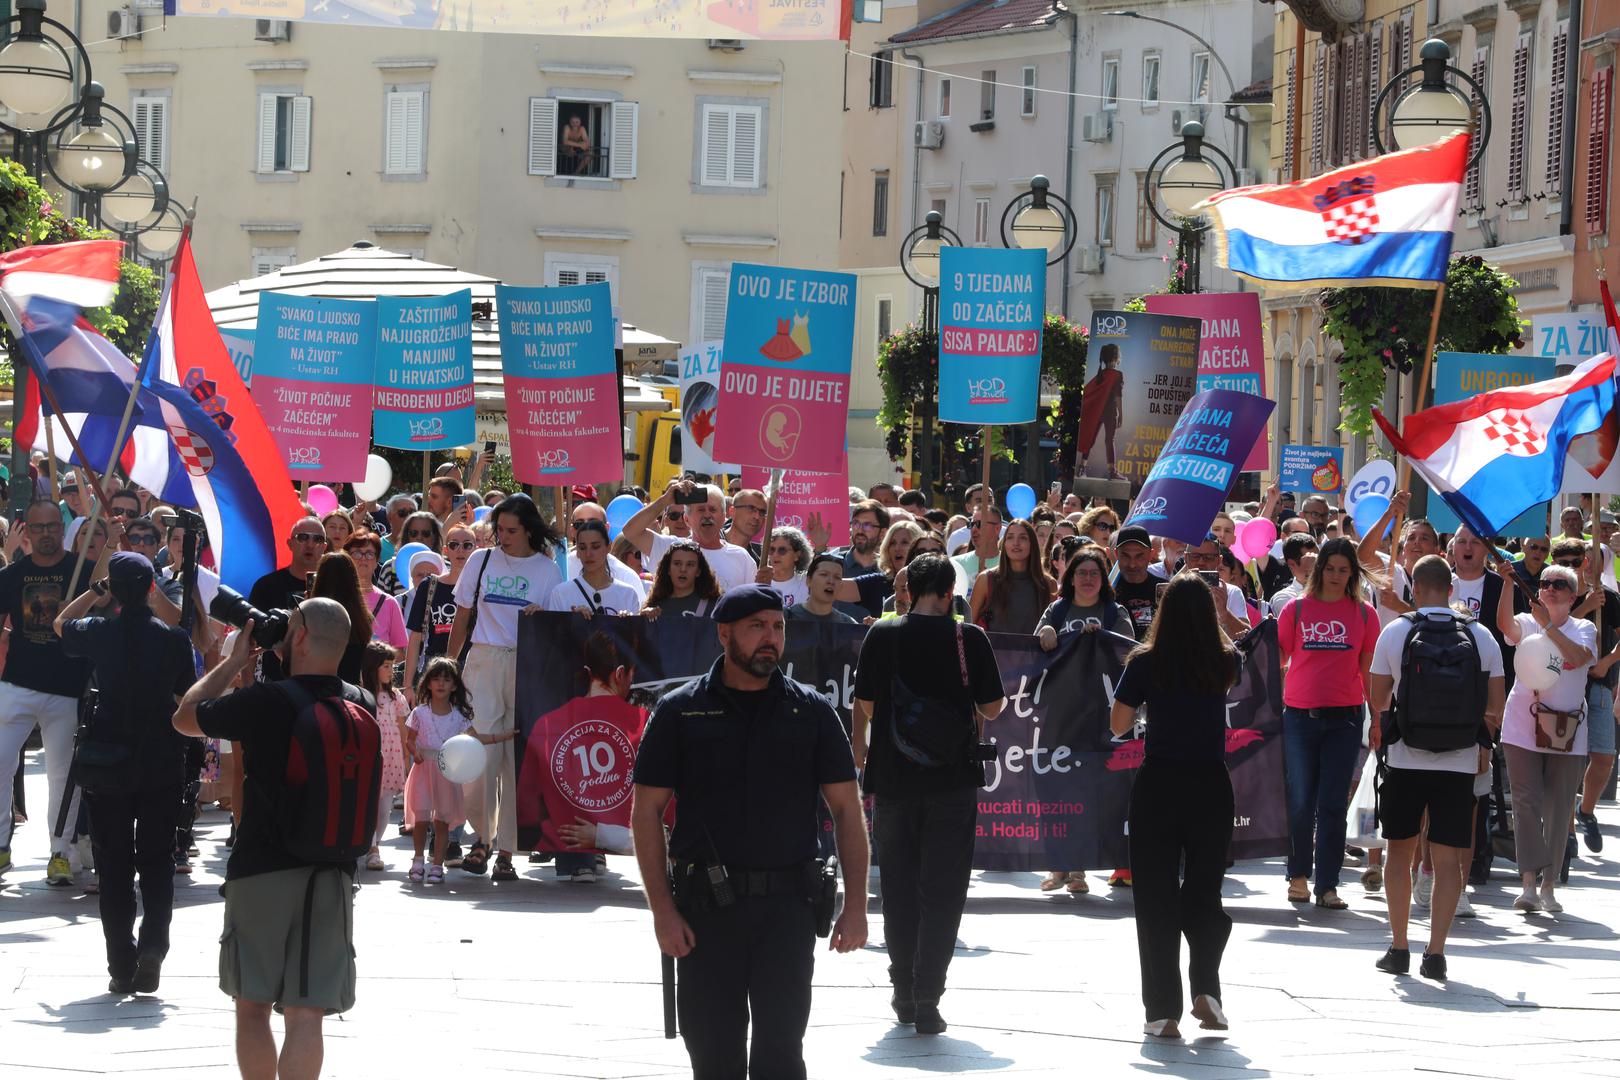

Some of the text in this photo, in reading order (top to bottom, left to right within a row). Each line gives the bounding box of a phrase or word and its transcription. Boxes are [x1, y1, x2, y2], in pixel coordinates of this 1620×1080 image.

[738, 274, 850, 306] OVO JE IZBOR
[954, 272, 1033, 293] 9 TJEDANA
[398, 304, 458, 324] ZAŠTITIMO
[544, 298, 592, 315] LJUDSKO
[952, 300, 1032, 323] OD ZAČEĆA
[317, 310, 361, 326] LJUDSKO
[1096, 316, 1127, 330] HOD
[277, 324, 358, 345] BIĆE IMA PRAVO
[381, 322, 469, 344] NAJUGROŽENIJU
[511, 319, 530, 336] BIĆE
[534, 321, 554, 336] IMA
[557, 319, 593, 336] PRAVO
[1160, 326, 1177, 338] ONA
[944, 330, 973, 352] SISA
[978, 333, 1025, 353] PALAC
[1540, 320, 1608, 356] ZA ŽIV
[290, 347, 304, 360] NA
[402, 346, 456, 365] MANJINU
[524, 343, 538, 357] NA
[1198, 345, 1250, 369] AČEĆA
[298, 364, 320, 374] Ustav
[324, 366, 338, 375] RH
[533, 360, 558, 370] Ustav
[560, 360, 576, 370] RH
[683, 354, 702, 379] ZA
[390, 365, 465, 385] U HRVATSKOJ
[1153, 374, 1168, 386] JER
[1170, 376, 1183, 387] JOJ
[1184, 377, 1192, 388] JE
[1460, 368, 1535, 392] UNBORN
[724, 370, 844, 404] OVO JE DIJETE
[968, 378, 1006, 393] HOD
[310, 389, 352, 408] POČINJE
[377, 387, 472, 409] NEROĐENU DJECU
[549, 387, 596, 403] POČINJE
[1150, 402, 1161, 414] DA
[1162, 403, 1172, 415] SE
[409, 418, 442, 433] HOD
[1188, 408, 1233, 428] DANA
[282, 426, 326, 436] medicinska
[328, 428, 359, 438] fakulteta
[530, 428, 572, 437] medicinska
[574, 426, 610, 436] fakulteta
[1125, 442, 1139, 456] ZA
[1168, 430, 1230, 456] ZAČEĆA
[288, 447, 320, 460] HOD
[537, 448, 568, 466] HOD
[1117, 460, 1132, 474] OD
[1172, 456, 1228, 484] ŠTUCA
[808, 497, 840, 505] fakulteta
[486, 575, 530, 591] HOD
[430, 603, 458, 620] HO
[1300, 620, 1346, 636] HOD
[556, 724, 632, 773] GENERACIJA ZA ŽIVOT
[572, 741, 616, 777] 10
[578, 772, 620, 794] godina
[578, 796, 594, 807] HOD
[607, 788, 625, 805] ŽIVOT
[1026, 800, 1084, 818] njezino
[992, 822, 1039, 840] Hodaj
[1043, 822, 1048, 838] i
[1052, 822, 1067, 838] ti!
